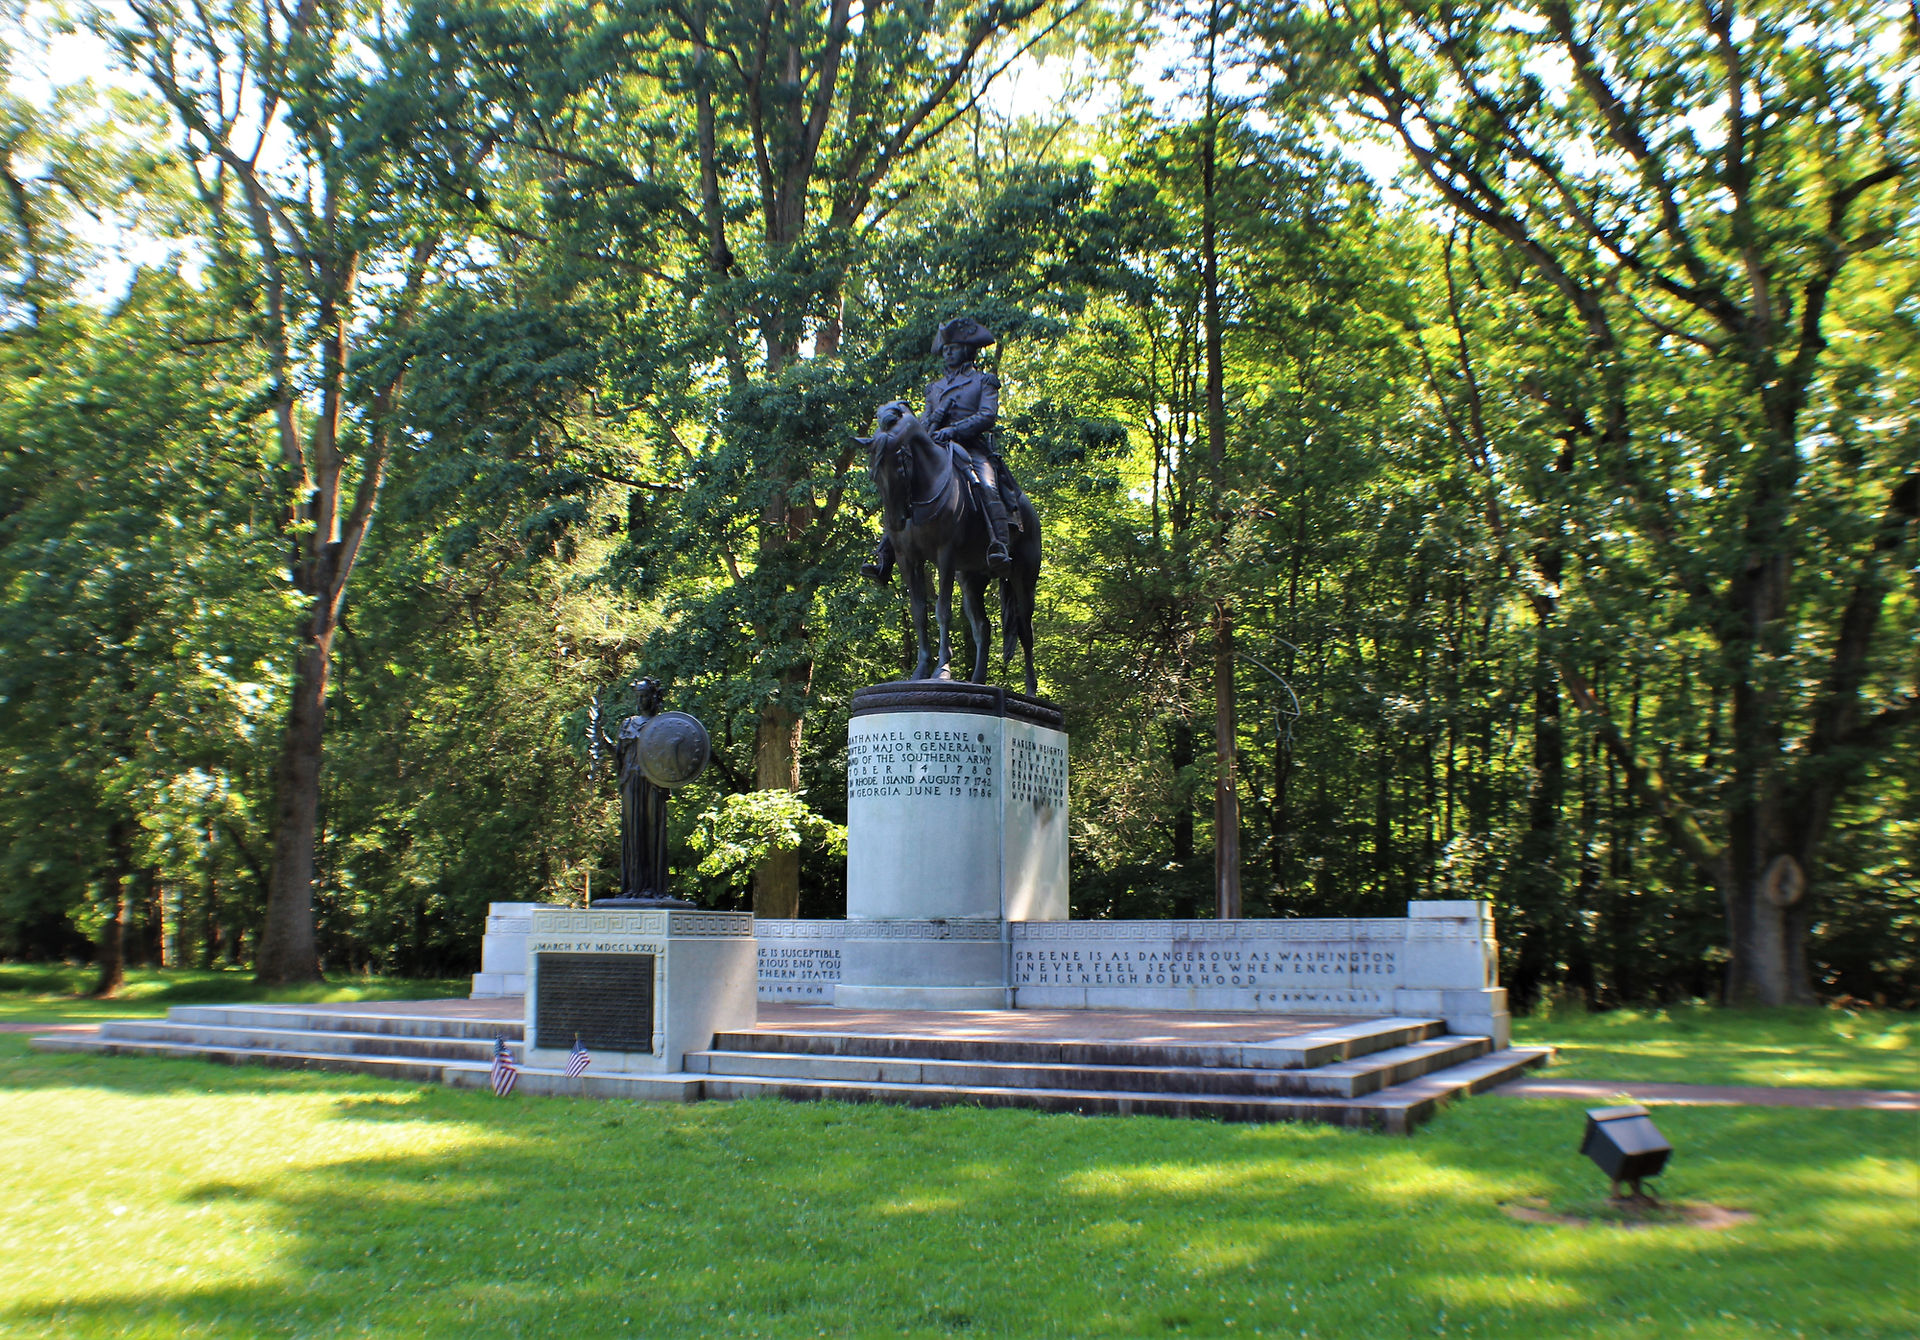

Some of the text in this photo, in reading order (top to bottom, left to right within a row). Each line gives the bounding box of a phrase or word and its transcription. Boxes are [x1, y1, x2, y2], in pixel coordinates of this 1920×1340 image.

[914, 731, 969, 741] GREENE
[872, 742, 913, 753] MAJOR
[920, 742, 976, 753] GENERAL
[982, 745, 991, 754] IN
[862, 755, 872, 765] OF
[877, 754, 895, 763] THE
[901, 753, 960, 763] SOUTHERN
[966, 755, 992, 766] ARMY
[909, 764, 928, 773] 14
[944, 765, 992, 776] 1780
[855, 776, 878, 787] RHODE
[882, 776, 915, 784] ISLAND
[920, 776, 960, 785] AUGUST
[964, 776, 969, 785] 7
[974, 777, 992, 787] 1742
[856, 787, 901, 798] GEORGIA
[907, 787, 941, 796] JUNE
[950, 787, 961, 796] 19
[537, 943, 656, 953] MARCH XV MDCCLXXXI
[771, 949, 777, 957] IS
[781, 949, 841, 959] SUSCEPTIBLE
[1015, 951, 1395, 962] GREENE IS AS DANGEROUS AS WASHINGTON
[793, 960, 813, 968] END
[819, 960, 841, 969] YOU
[1027, 963, 1084, 972] NEVER
[1095, 963, 1133, 972] FEEL
[1148, 963, 1219, 973] SECURE
[1229, 963, 1283, 973] WHEN
[1295, 963, 1395, 974] ENCAMPED
[802, 970, 841, 979] STATES
[1016, 974, 1256, 984] IN HIS NEIGHBOURHOOD
